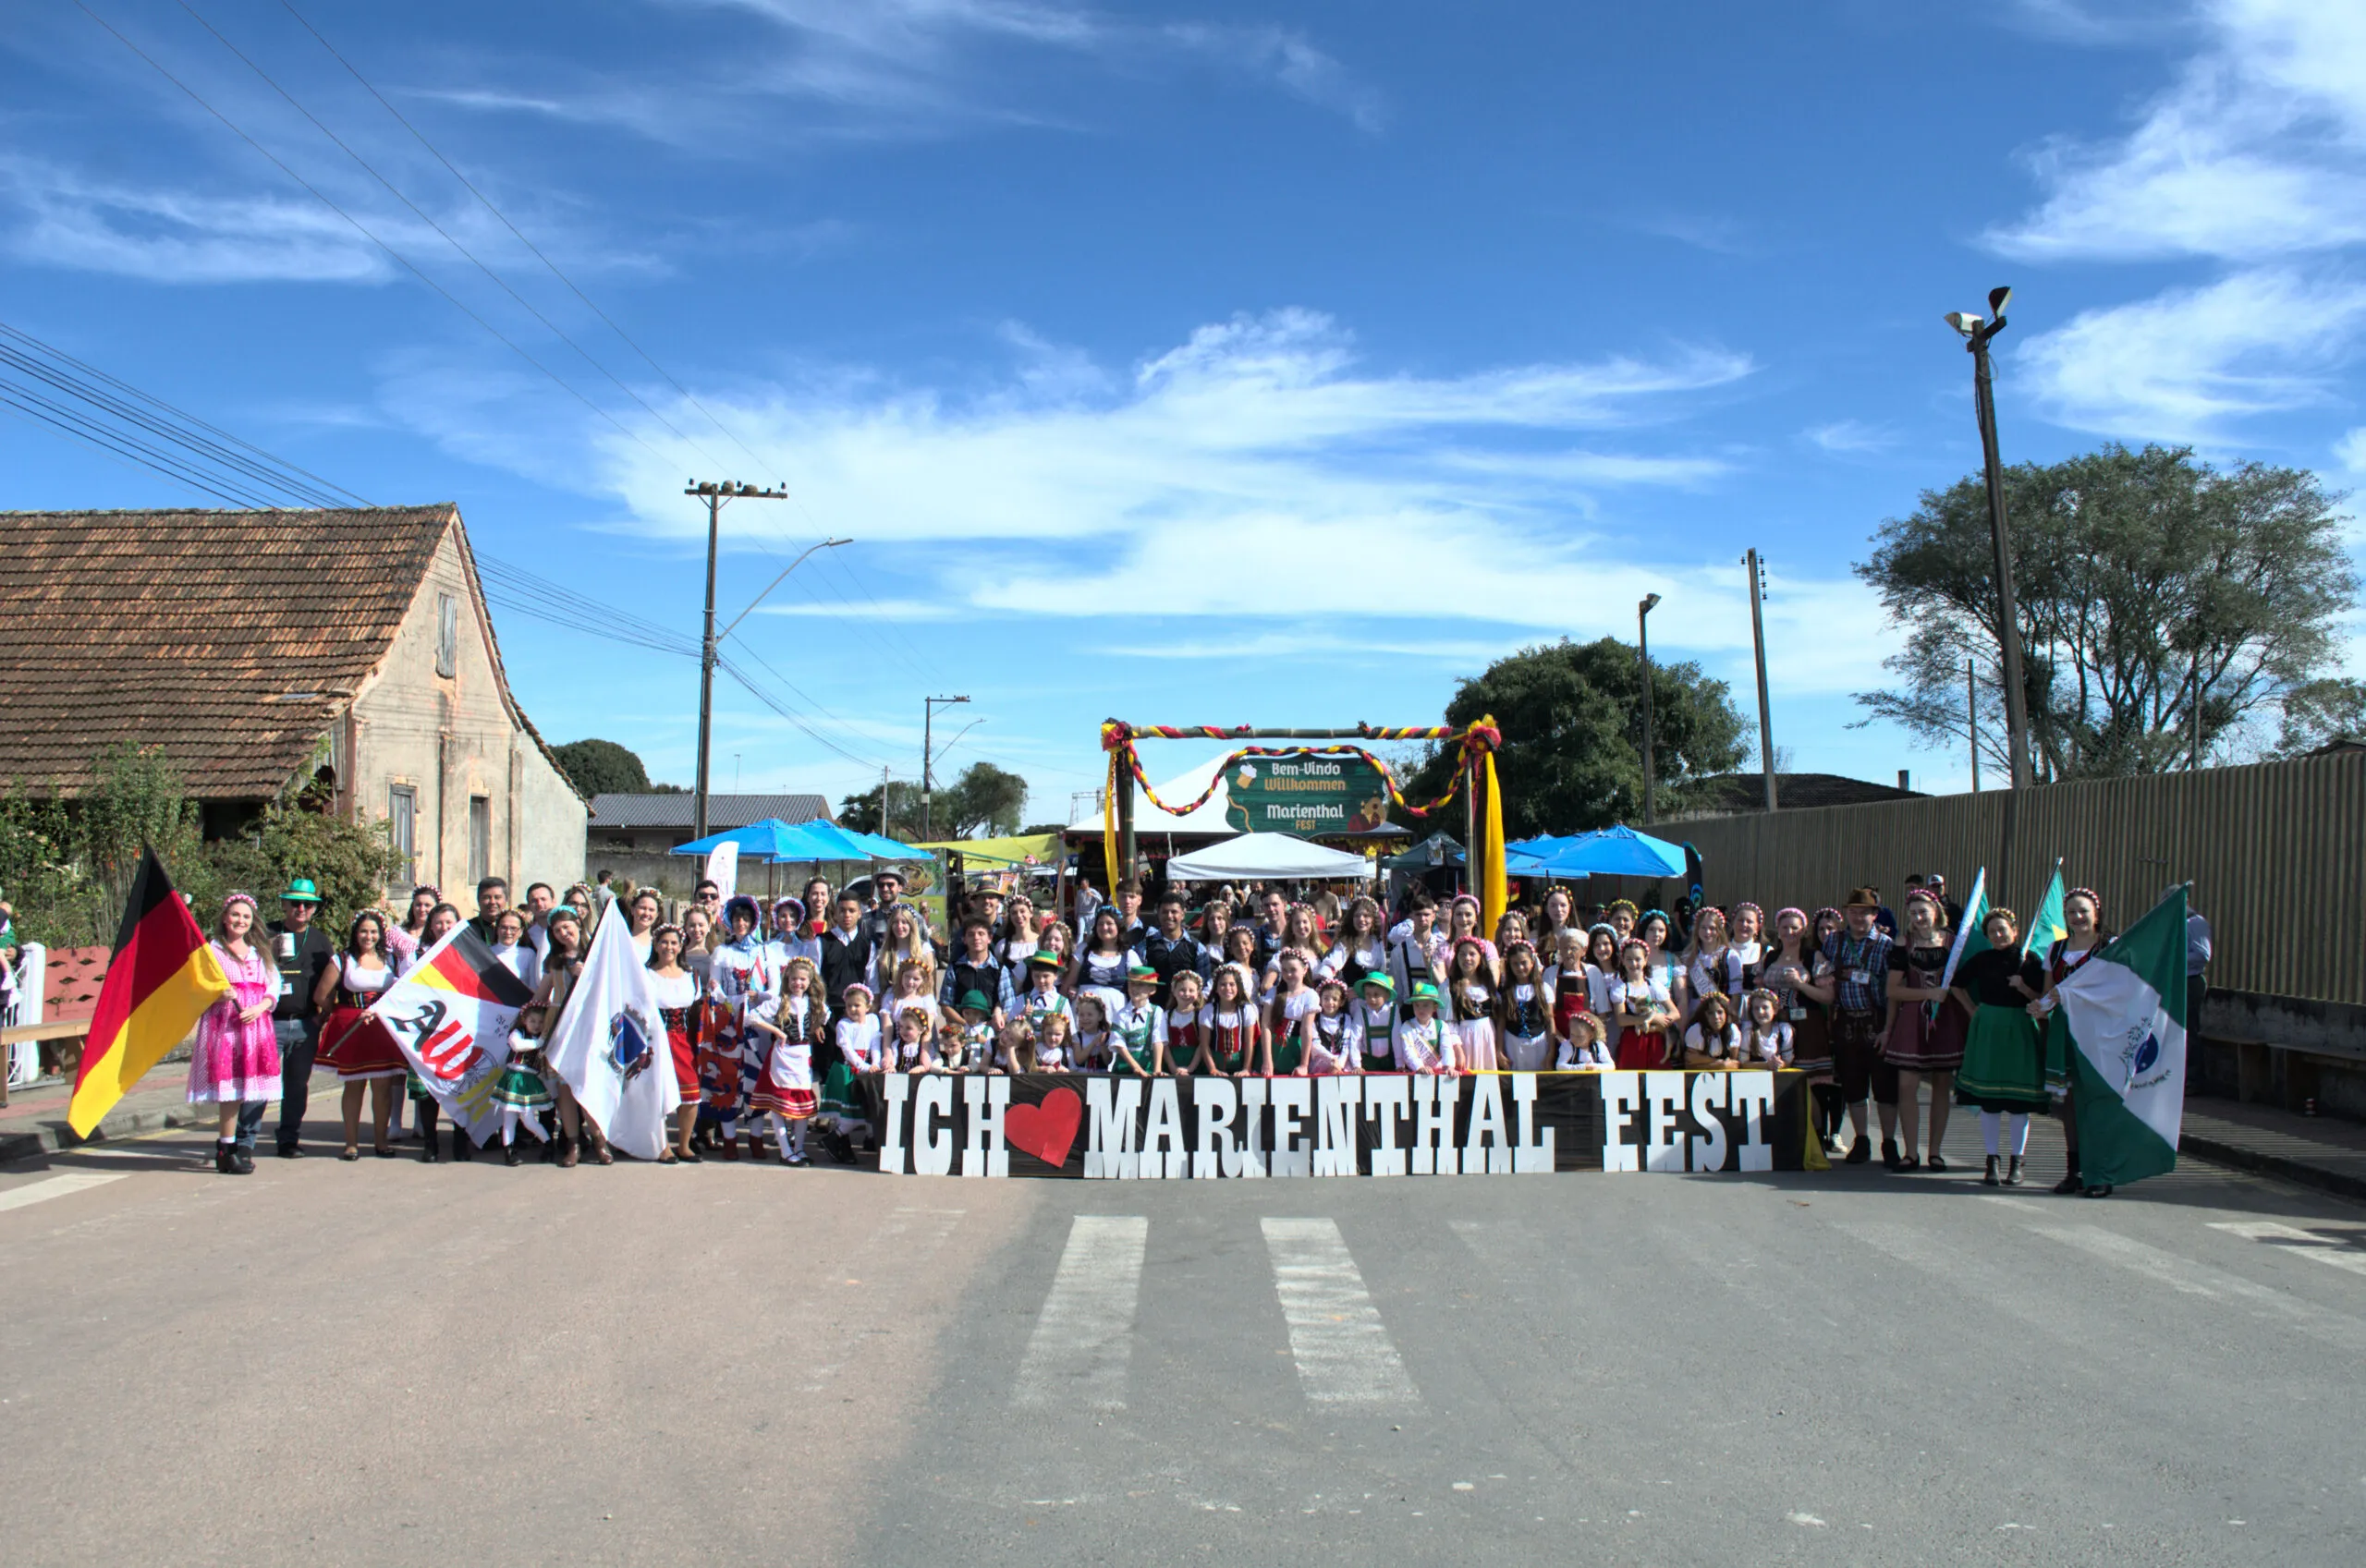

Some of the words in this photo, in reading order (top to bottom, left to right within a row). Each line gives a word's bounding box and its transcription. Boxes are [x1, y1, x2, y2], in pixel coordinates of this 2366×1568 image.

[1272, 761, 1340, 775] Bem-Vindo
[1264, 778, 1346, 791] Willkommen
[1267, 804, 1345, 819] Marienthal
[1296, 820, 1315, 830] FEST
[879, 1074, 1010, 1176] ICH
[1083, 1073, 1555, 1179] MARIENTHAL
[1600, 1071, 1774, 1173] FEST
